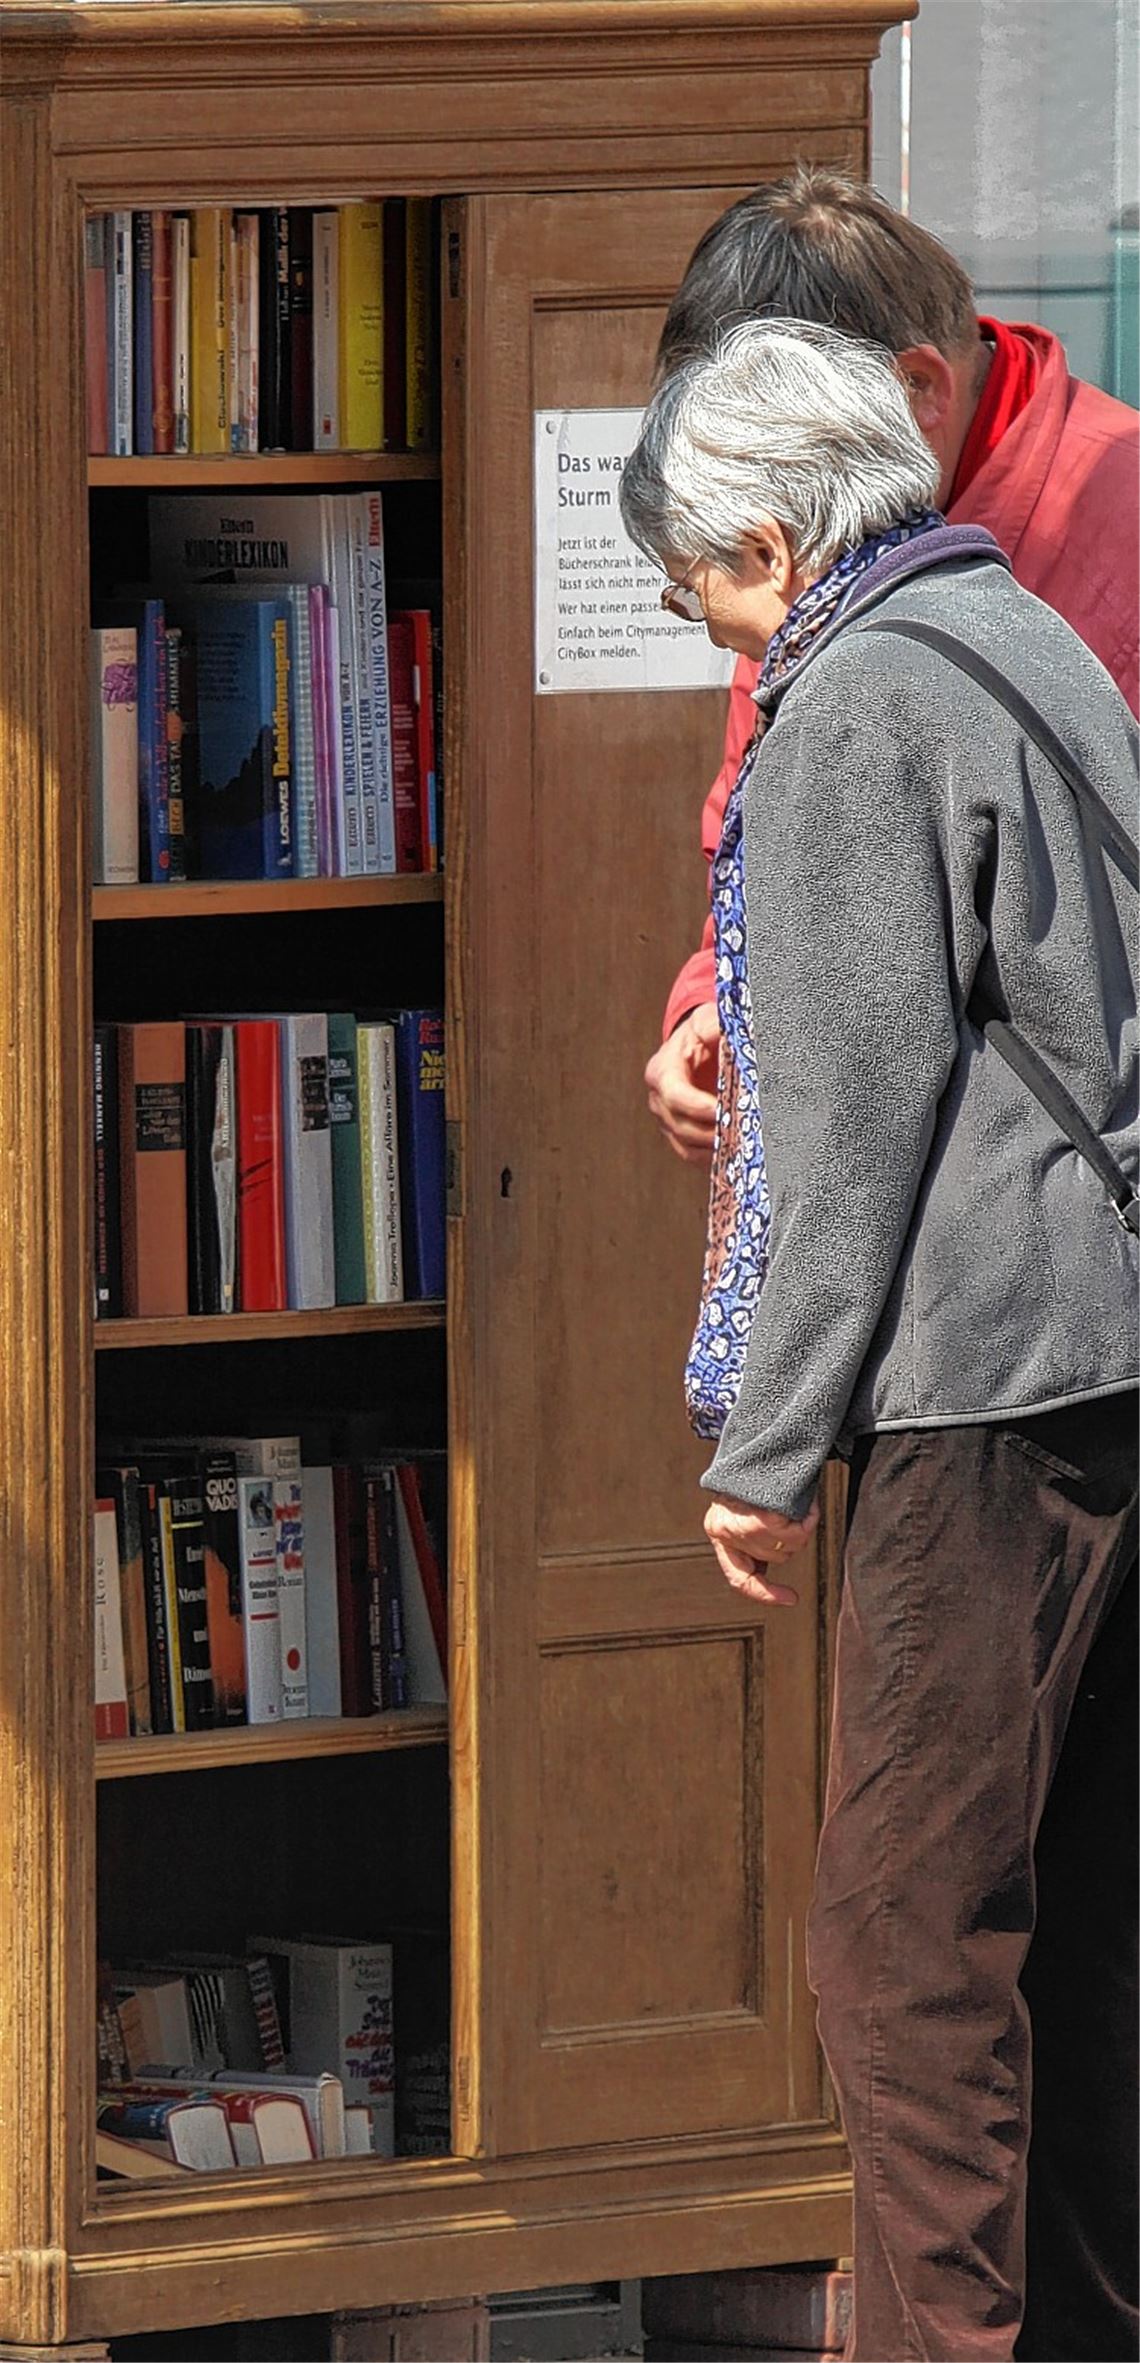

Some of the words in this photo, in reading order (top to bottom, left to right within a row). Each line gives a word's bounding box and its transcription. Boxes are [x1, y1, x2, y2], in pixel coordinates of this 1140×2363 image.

[558, 453, 591, 473] Das
[558, 487, 611, 507] Sturm
[367, 497, 382, 548] Eltern
[558, 537, 581, 551] Jetzt
[584, 537, 597, 549] ist
[600, 537, 617, 549] der
[558, 555, 632, 570] Bücherschrank
[368, 559, 382, 592] A-Z
[559, 576, 582, 590] lässt
[584, 575, 605, 589] sich
[608, 575, 634, 588] nicht
[636, 575, 662, 588] mehr
[369, 597, 385, 639] VON
[558, 603, 577, 615] Wer
[580, 601, 598, 614] hat
[600, 603, 627, 614] einen
[631, 602, 660, 616] passe
[558, 625, 594, 639] Einfach
[598, 624, 623, 637] beim
[626, 623, 706, 640] Citymanagement
[340, 662, 350, 681] A-Z
[557, 645, 596, 661] CityBox
[600, 645, 641, 659] melden.
[271, 620, 290, 777] Detektivmagazin
[342, 682, 351, 702] von
[371, 644, 388, 728] ERZIEHUNG
[359, 698, 372, 739] FEIERN
[342, 705, 356, 796] KINDERLEXIKON
[376, 733, 390, 779] richtige
[169, 765, 182, 793] DAS
[362, 751, 375, 798] SPIELEN
[379, 782, 391, 803] Die
[279, 781, 291, 845] LOEWES
[346, 807, 358, 848] Eltern
[363, 805, 375, 846] Eltern
[95, 1043, 103, 1091] HENNING
[382, 1040, 391, 1091] Sommer
[96, 1094, 104, 1142] MANKELL
[384, 1094, 392, 1109] im
[385, 1155, 396, 1181] Eine
[386, 1190, 398, 1240] Trollope
[389, 1242, 399, 1287] Joanna
[206, 1478, 237, 1496] QUO
